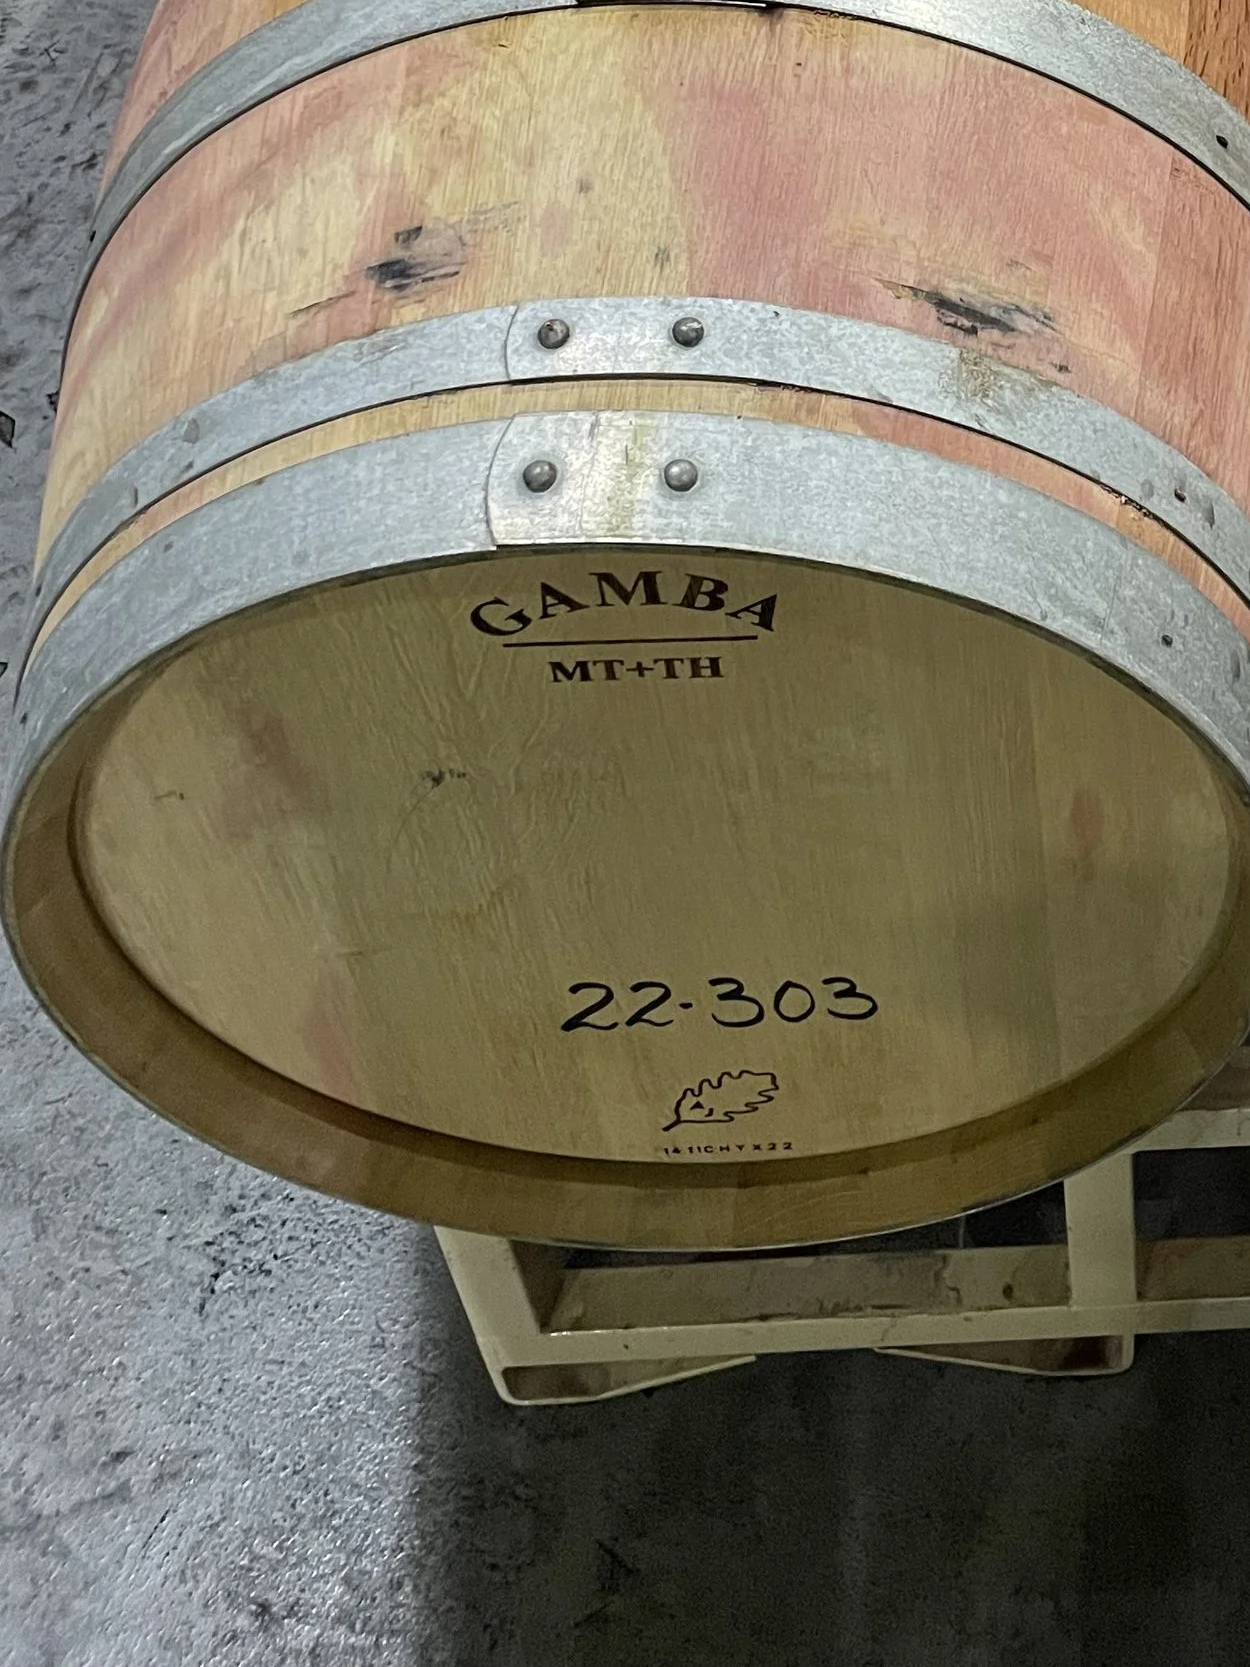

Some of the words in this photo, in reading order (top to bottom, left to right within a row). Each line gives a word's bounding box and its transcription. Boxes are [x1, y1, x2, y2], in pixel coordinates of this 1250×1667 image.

[470, 570, 778, 636] GAMBA
[548, 656, 725, 683] MT+TH
[560, 976, 878, 1032] 22-303
